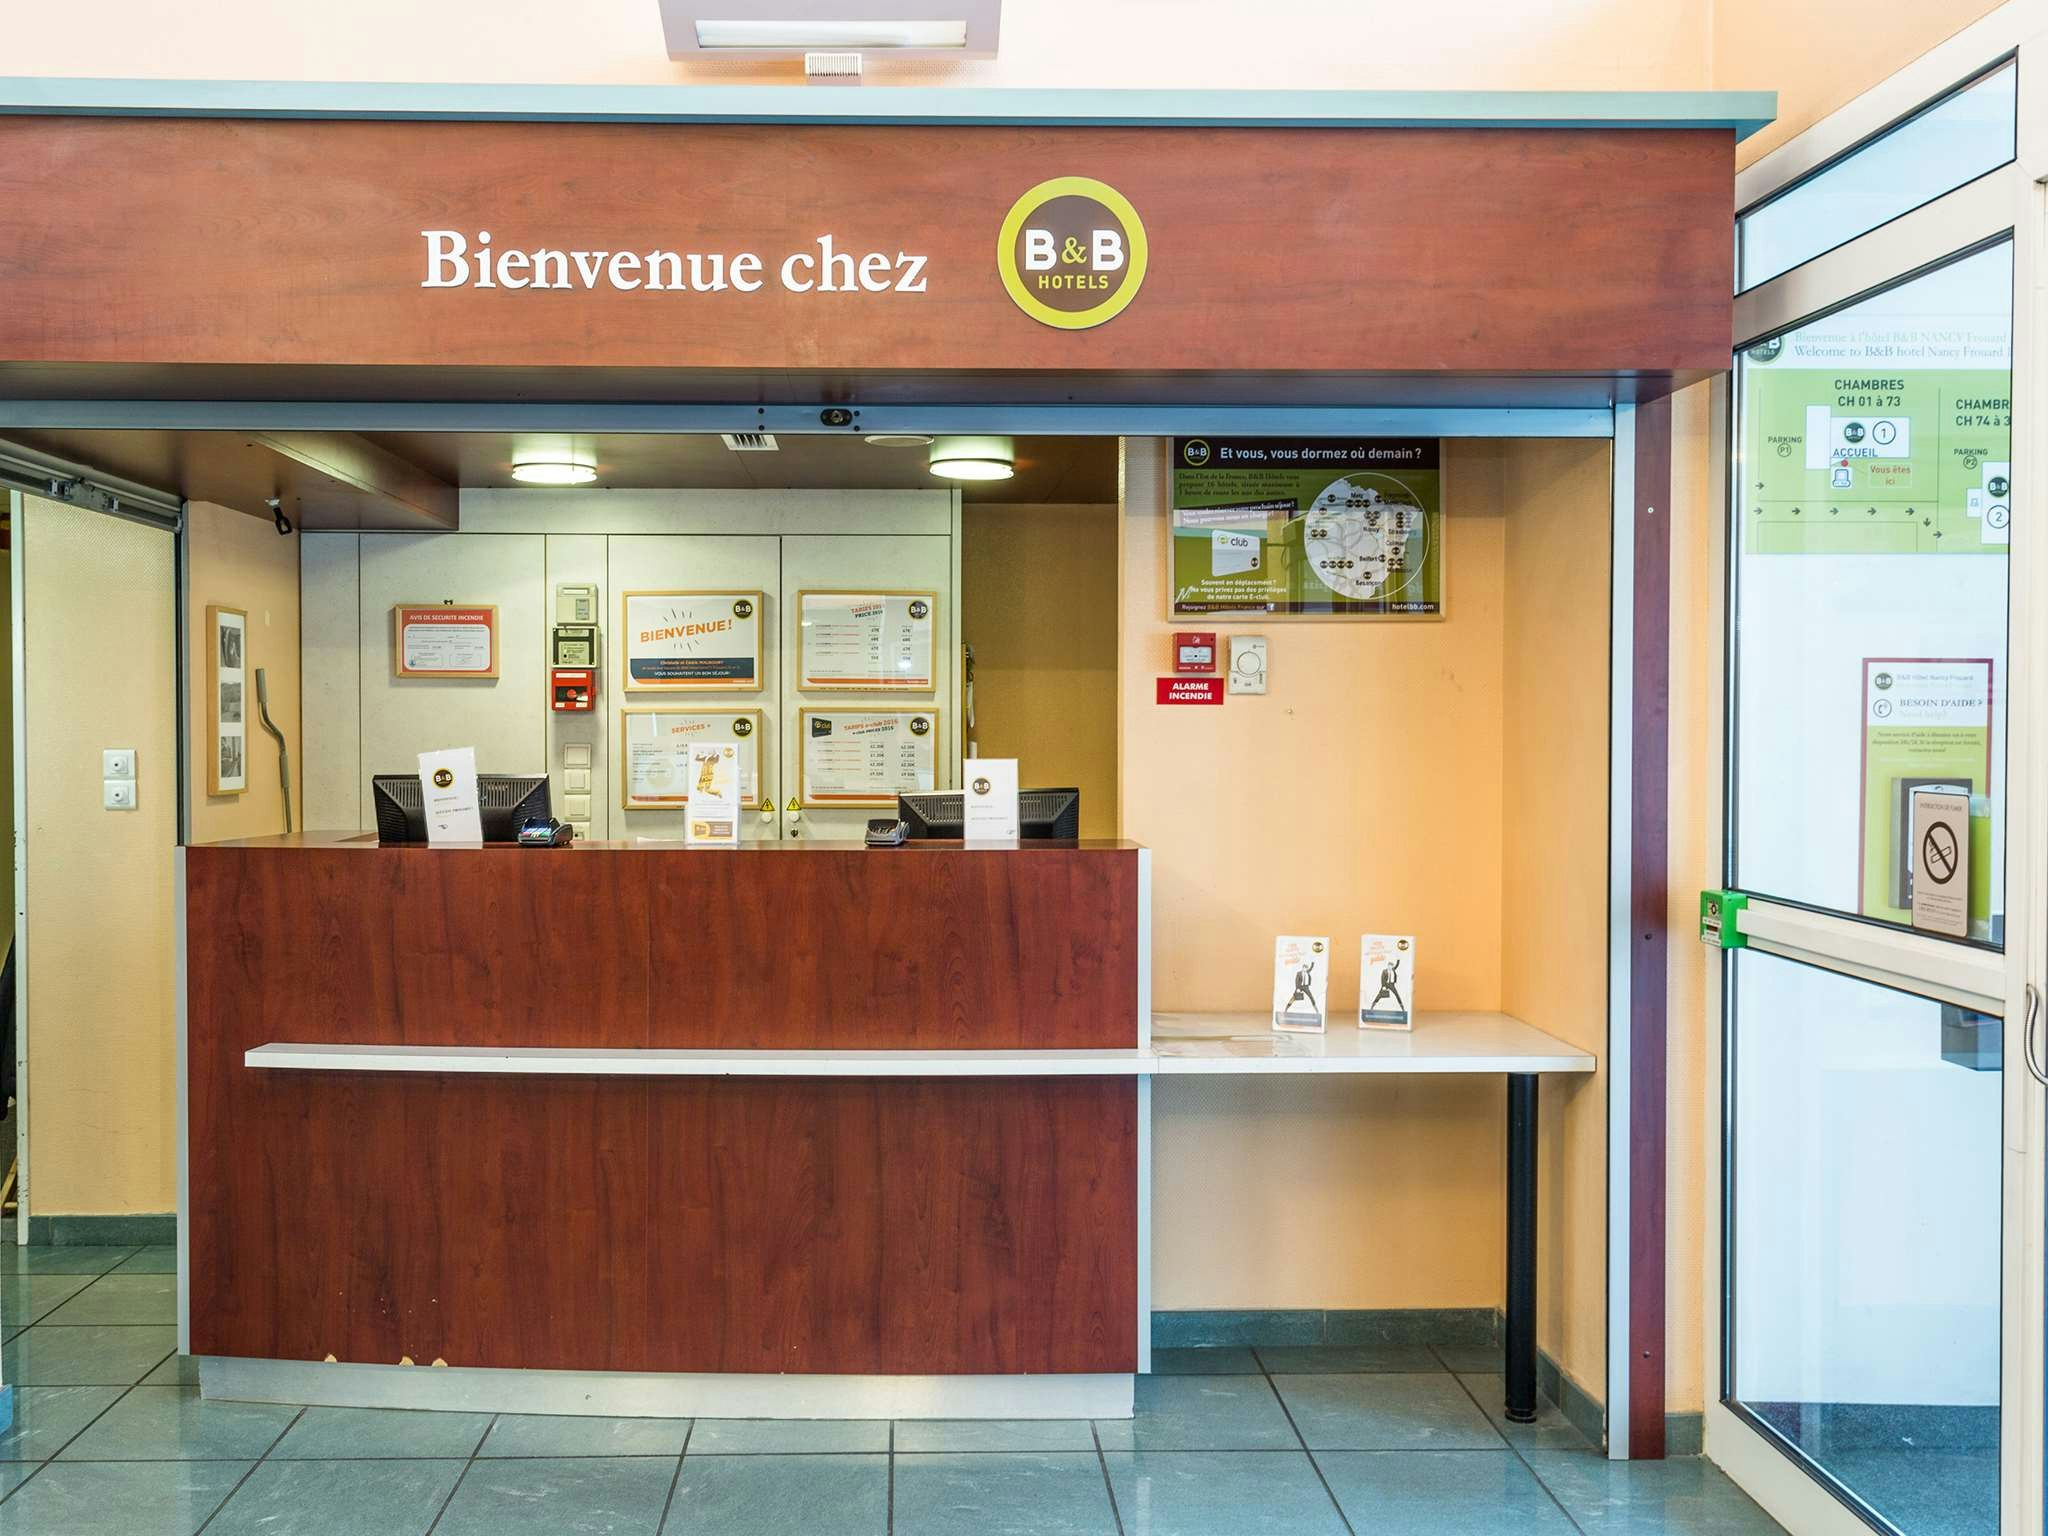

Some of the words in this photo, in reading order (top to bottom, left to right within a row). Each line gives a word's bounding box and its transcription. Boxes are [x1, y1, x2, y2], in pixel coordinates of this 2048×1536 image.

[1025, 229, 1124, 271] B&B
[421, 230, 764, 291] Bienvenue
[780, 234, 929, 293] chez
[1038, 275, 1109, 289] HOTELS
[1794, 345, 1848, 357] Welcome
[1850, 347, 1862, 357] to
[1865, 345, 1895, 357] B&B
[1896, 345, 1925, 357] hotel
[1927, 345, 1960, 359] Nancy
[1963, 345, 2004, 357] Frouard
[1834, 379, 1905, 391] CHAMBRES
[1837, 396, 1855, 407] CH
[1858, 396, 1873, 407] 01
[1876, 395, 1884, 407] à
[1886, 396, 1901, 407] 73
[1955, 416, 1973, 427] CH
[1976, 416, 1991, 427] 74
[1993, 415, 2000, 427] à
[1880, 428, 1888, 439] 1
[1767, 436, 1803, 444] PARKING
[1187, 447, 1207, 457] B&B
[1220, 447, 1233, 459] Et
[1236, 449, 1268, 461] vous,
[1271, 449, 1298, 459] vous
[1301, 447, 1348, 459] dormez
[1351, 446, 1365, 459] où
[1368, 447, 1413, 459] demain
[1415, 447, 1422, 459] ?
[1833, 448, 1879, 457] ACCUEIL
[1870, 465, 1892, 474] Vous
[1893, 465, 1911, 474] êtes
[1885, 478, 1896, 486] ici
[1995, 512, 2002, 522] 2
[1230, 537, 1248, 547] club
[735, 605, 752, 613] B&B
[910, 606, 927, 614] B&B
[640, 620, 726, 643] BIENVENUE
[1172, 682, 1209, 690] ALARME
[1169, 692, 1212, 700] INCENDIE
[1899, 698, 1938, 707] BESOIN
[1940, 698, 1976, 707] D'AIDE
[671, 723, 705, 734] SERVICES
[735, 723, 751, 731] B&B
[912, 721, 928, 729] B&B
